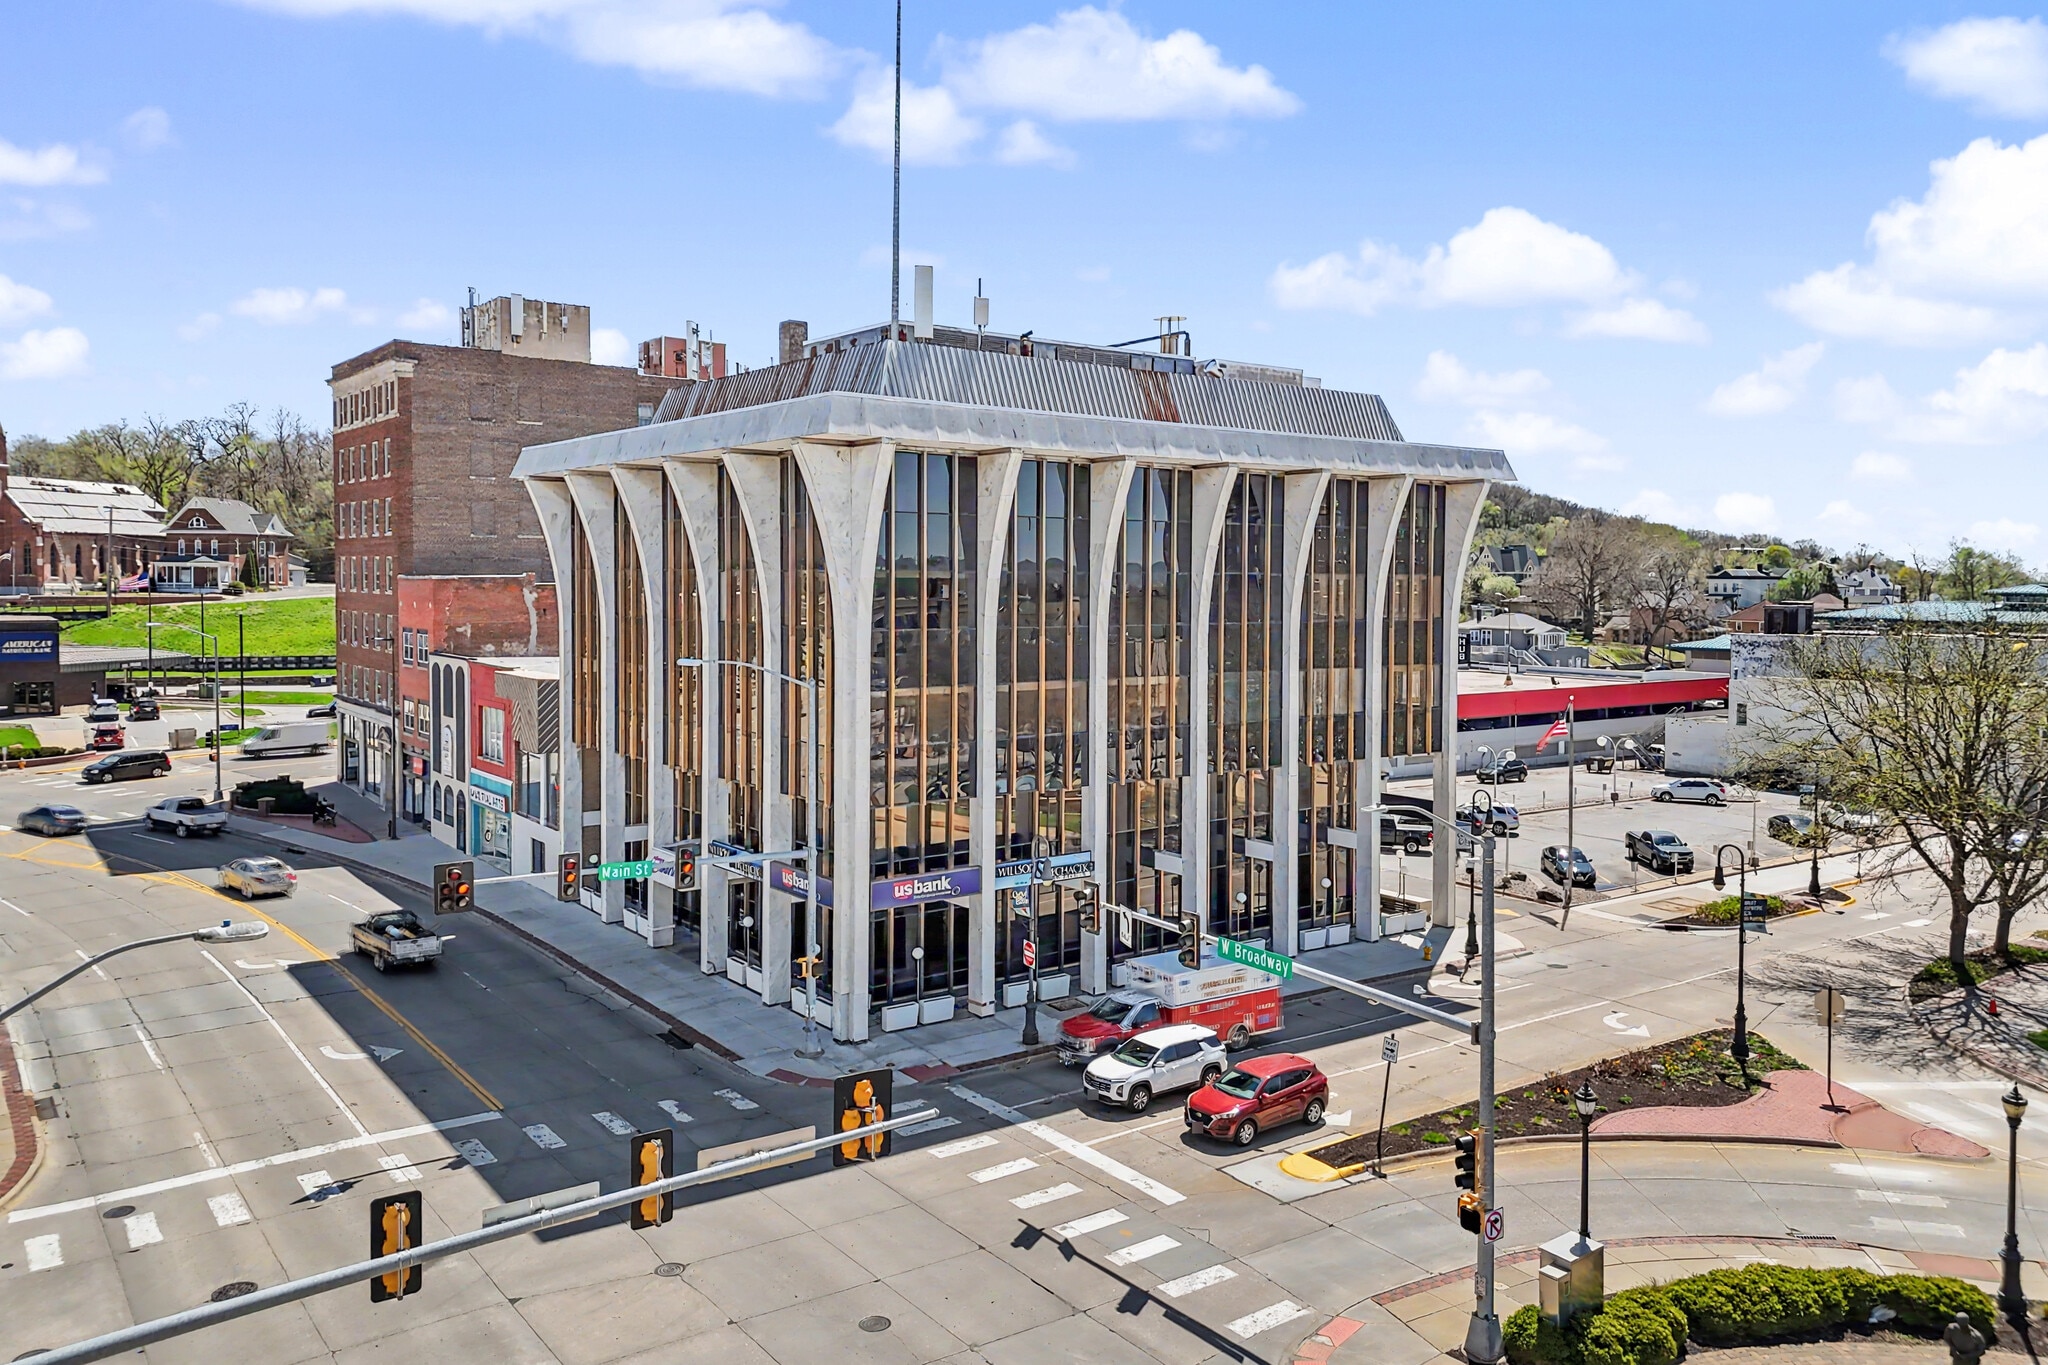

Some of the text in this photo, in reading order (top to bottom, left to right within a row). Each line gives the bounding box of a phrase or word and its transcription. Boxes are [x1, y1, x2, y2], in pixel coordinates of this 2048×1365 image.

[602, 864, 631, 879] Main
[635, 863, 649, 876] St
[782, 870, 809, 891] usban
[1221, 939, 1289, 978] W Broadway
